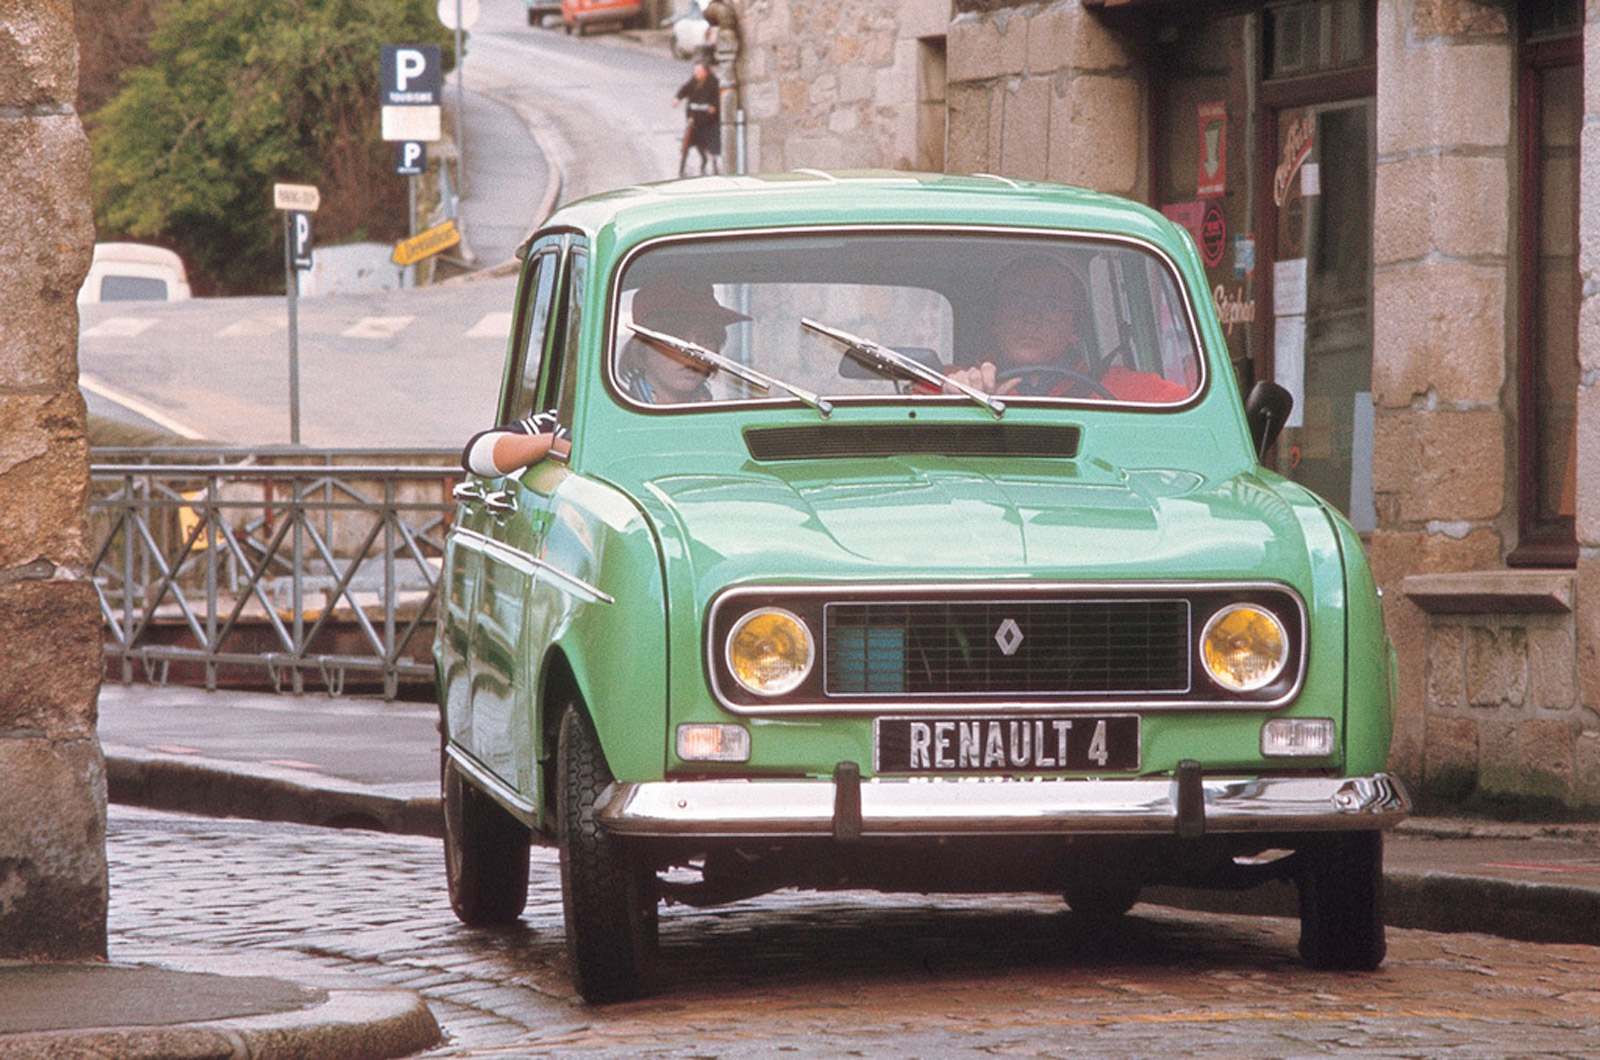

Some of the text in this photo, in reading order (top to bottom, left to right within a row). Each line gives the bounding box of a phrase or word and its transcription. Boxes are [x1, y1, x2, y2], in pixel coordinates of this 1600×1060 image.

[396, 49, 426, 91] P
[404, 142, 422, 168] P
[296, 213, 309, 255] P
[909, 719, 1109, 769] RENAULT 4
